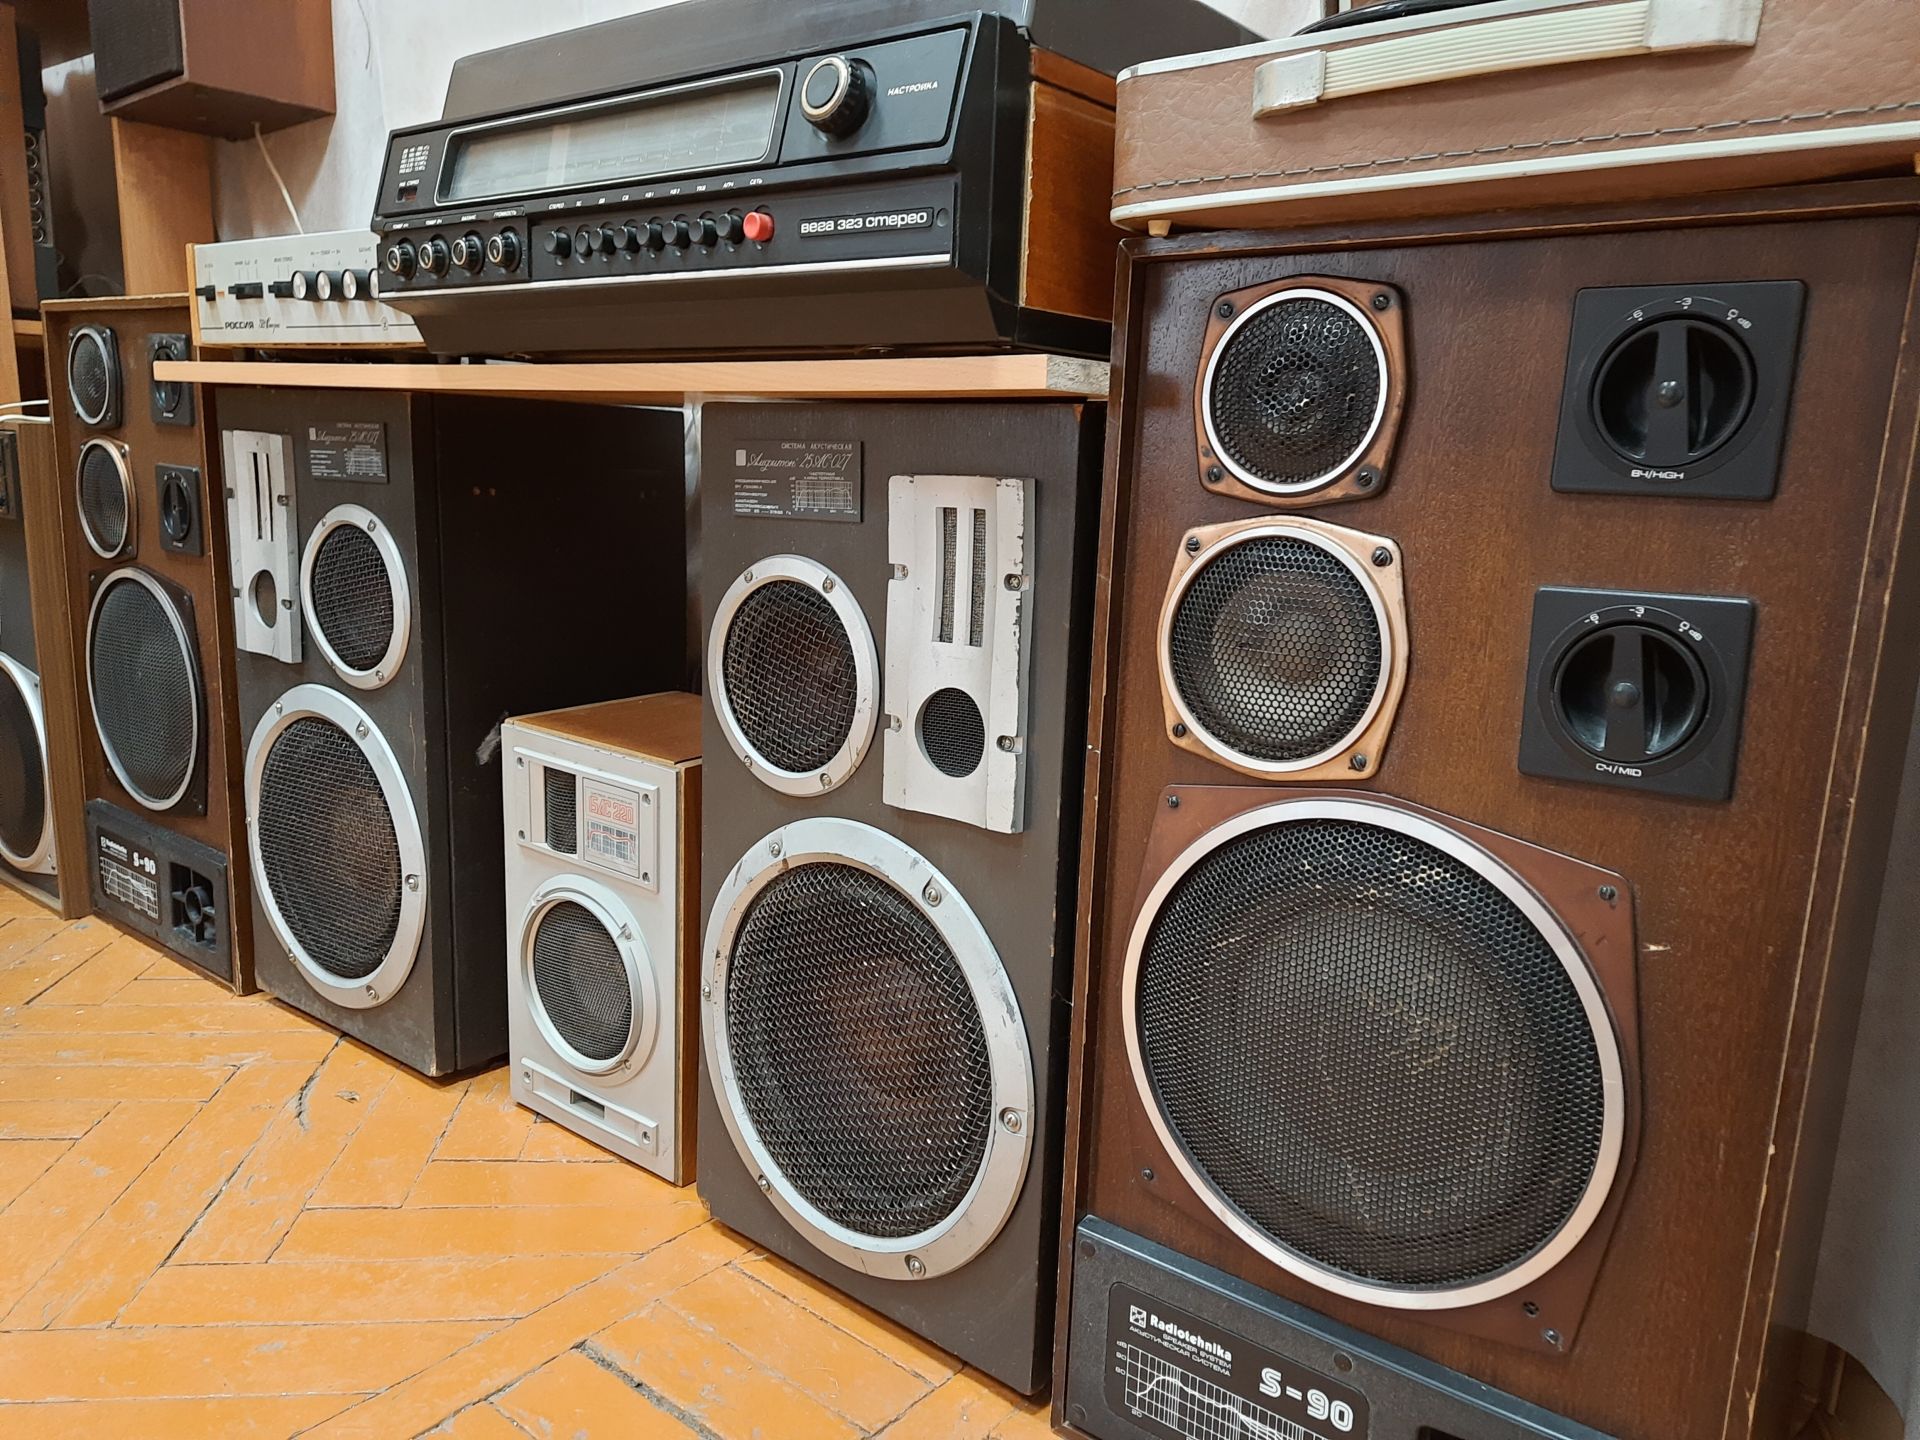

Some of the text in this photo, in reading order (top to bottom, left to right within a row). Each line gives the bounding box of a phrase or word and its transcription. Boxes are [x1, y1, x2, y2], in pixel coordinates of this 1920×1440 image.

[837, 220, 863, 230] 323
[1150, 1314, 1232, 1362] Radiotehnika
[1162, 1333, 1232, 1370] SPEAKER SYSTEM
[1192, 1354, 1232, 1376] СИСТЕМА
[1258, 1366, 1354, 1432] S-90
